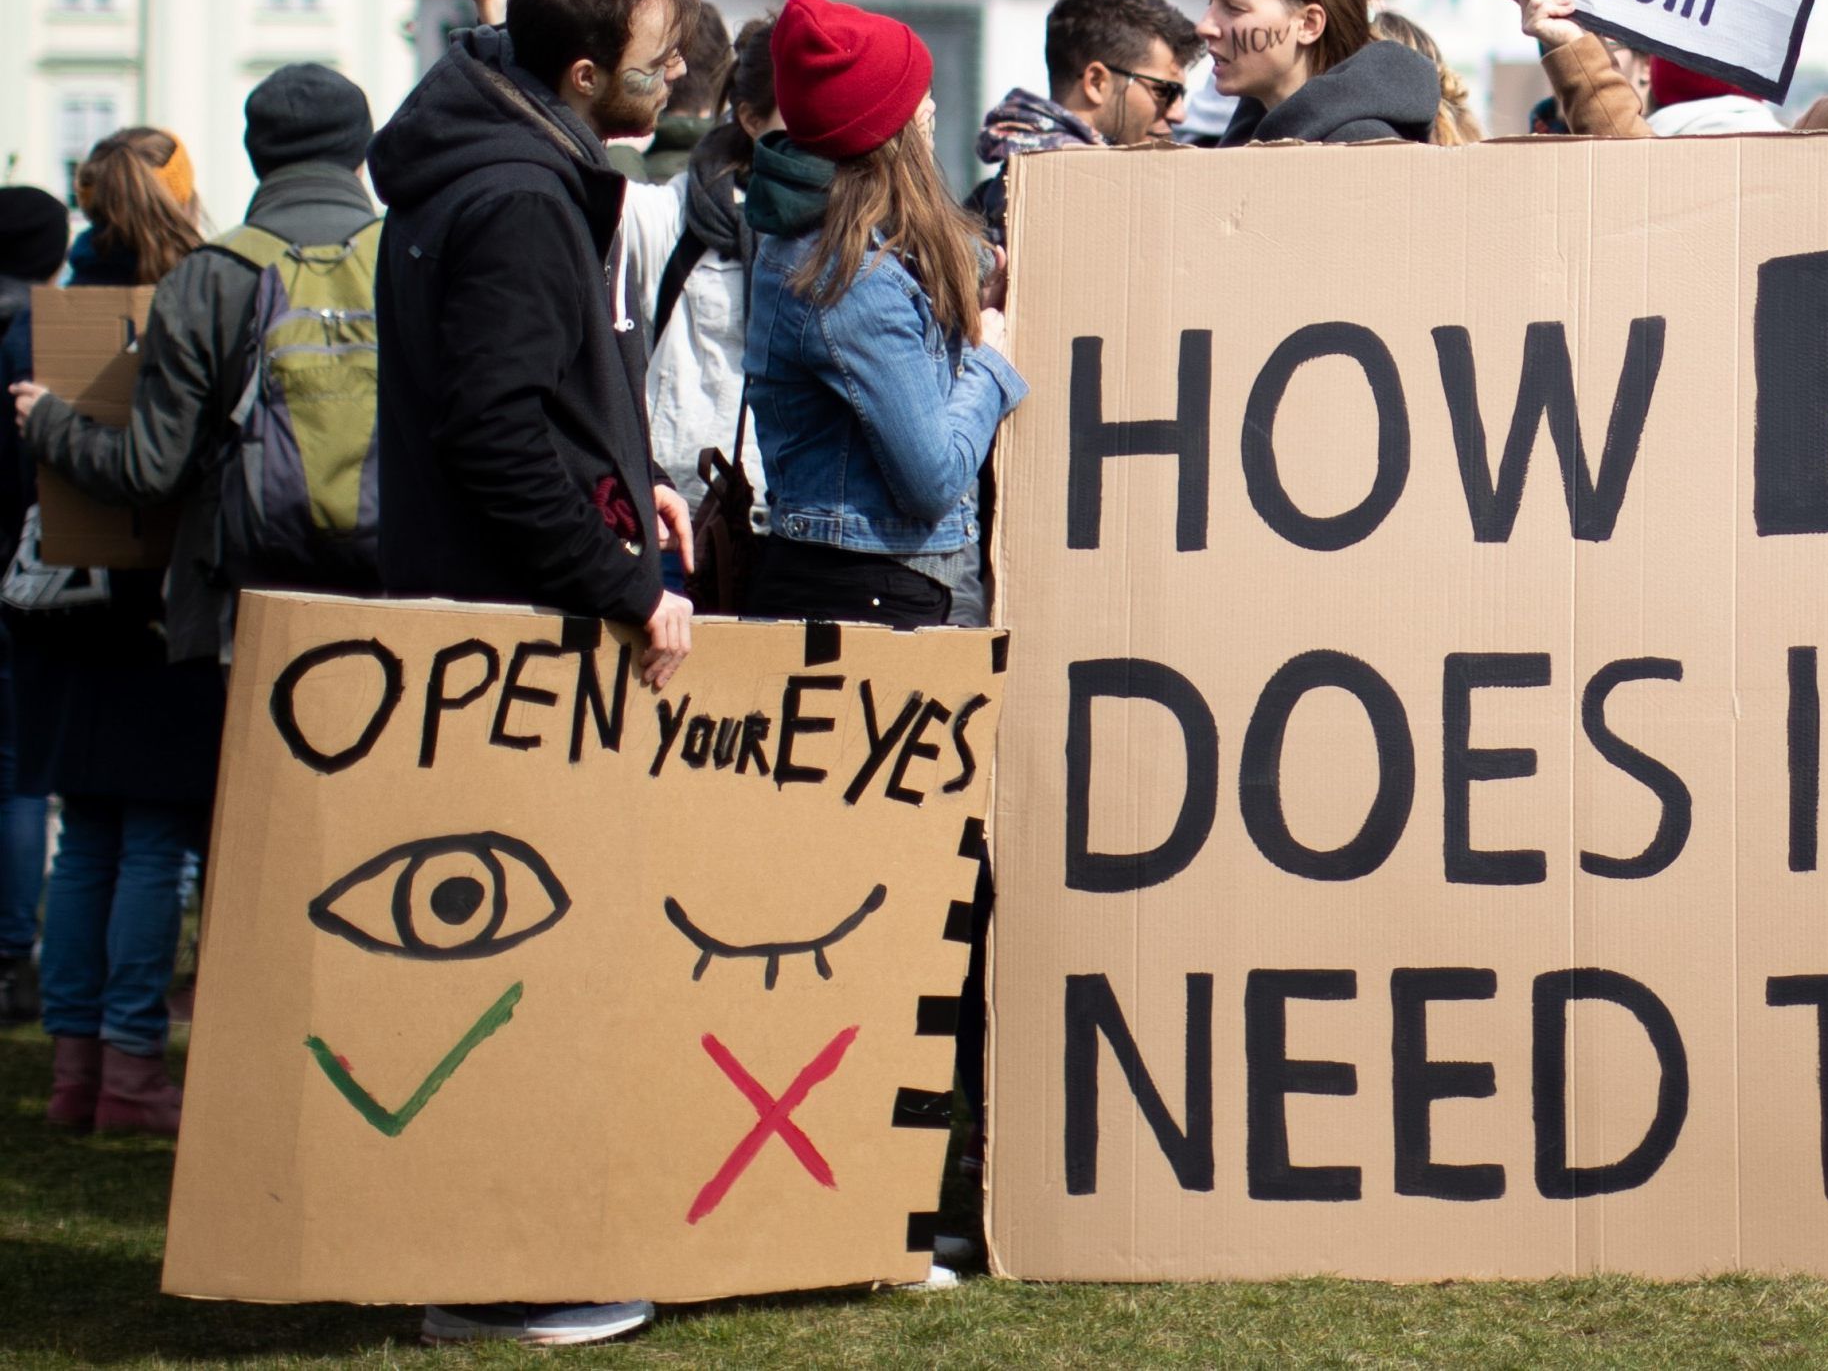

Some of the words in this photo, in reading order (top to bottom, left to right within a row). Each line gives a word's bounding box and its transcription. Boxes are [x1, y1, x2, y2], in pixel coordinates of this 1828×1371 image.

[1231, 24, 1291, 60] NOW
[1065, 315, 1667, 553] HOW
[269, 637, 632, 776] OPEN
[648, 692, 774, 779] YOUR
[772, 674, 994, 808] EYES
[1065, 647, 1692, 893] DOES
[1065, 963, 1689, 1204] NEED
